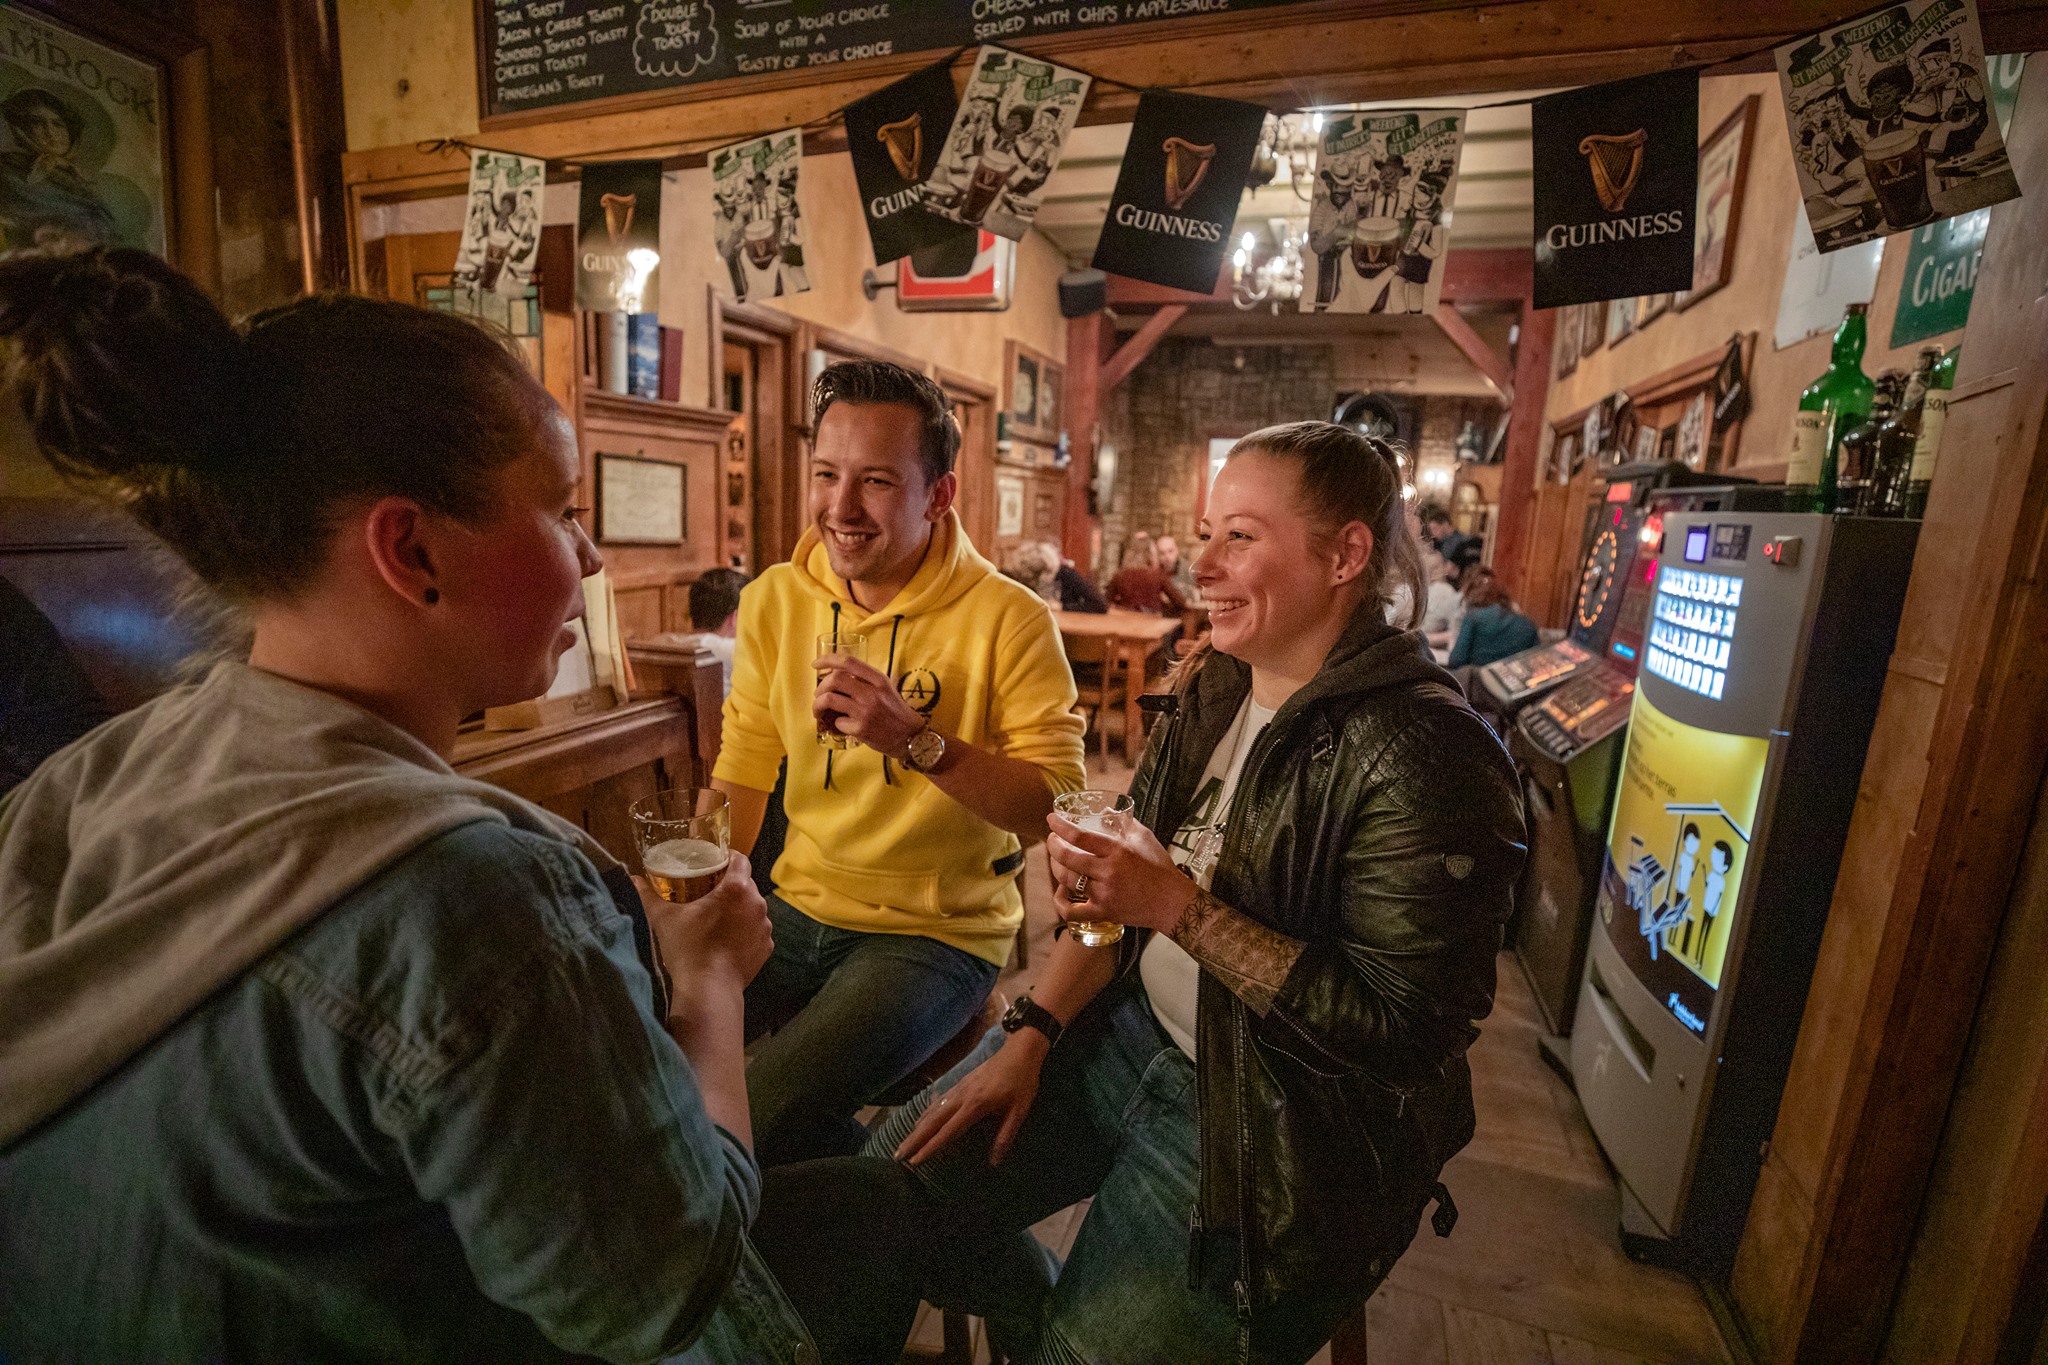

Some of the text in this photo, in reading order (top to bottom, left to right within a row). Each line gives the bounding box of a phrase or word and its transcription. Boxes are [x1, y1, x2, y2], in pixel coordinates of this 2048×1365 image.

[525, 1, 564, 19] TOASTY
[650, 2, 699, 24] DOUBLE
[734, 4, 890, 39] SOUP OF YOUR CHOICE
[973, 15, 1026, 40] SERVED
[1033, 8, 1069, 26] WITH
[1077, 5, 1118, 23] CHIPS
[1135, 0, 1229, 18] APPLESAUCE
[498, 27, 532, 46] BACON
[545, 15, 585, 36] CHEESE
[587, 5, 625, 23] TOASTY
[664, 20, 691, 36] YOUR
[1842, 12, 1892, 43] WEEKEND
[1899, 2, 1949, 48] TOGETHER
[1937, 15, 1967, 37] MARCH
[542, 35, 586, 53] TOMATO
[587, 26, 628, 44] TOASTY
[651, 30, 700, 51] TOASTY
[779, 32, 827, 49] WITH A
[544, 53, 587, 72] TOASTY
[735, 40, 893, 73] TOASTY OF YOUR CHOICE
[566, 73, 604, 89] TOASTY
[870, 183, 926, 219] GUIN
[1115, 203, 1224, 243] GUINNESS
[1545, 210, 1684, 250] GUINNESS
[582, 252, 627, 273] GUIN
